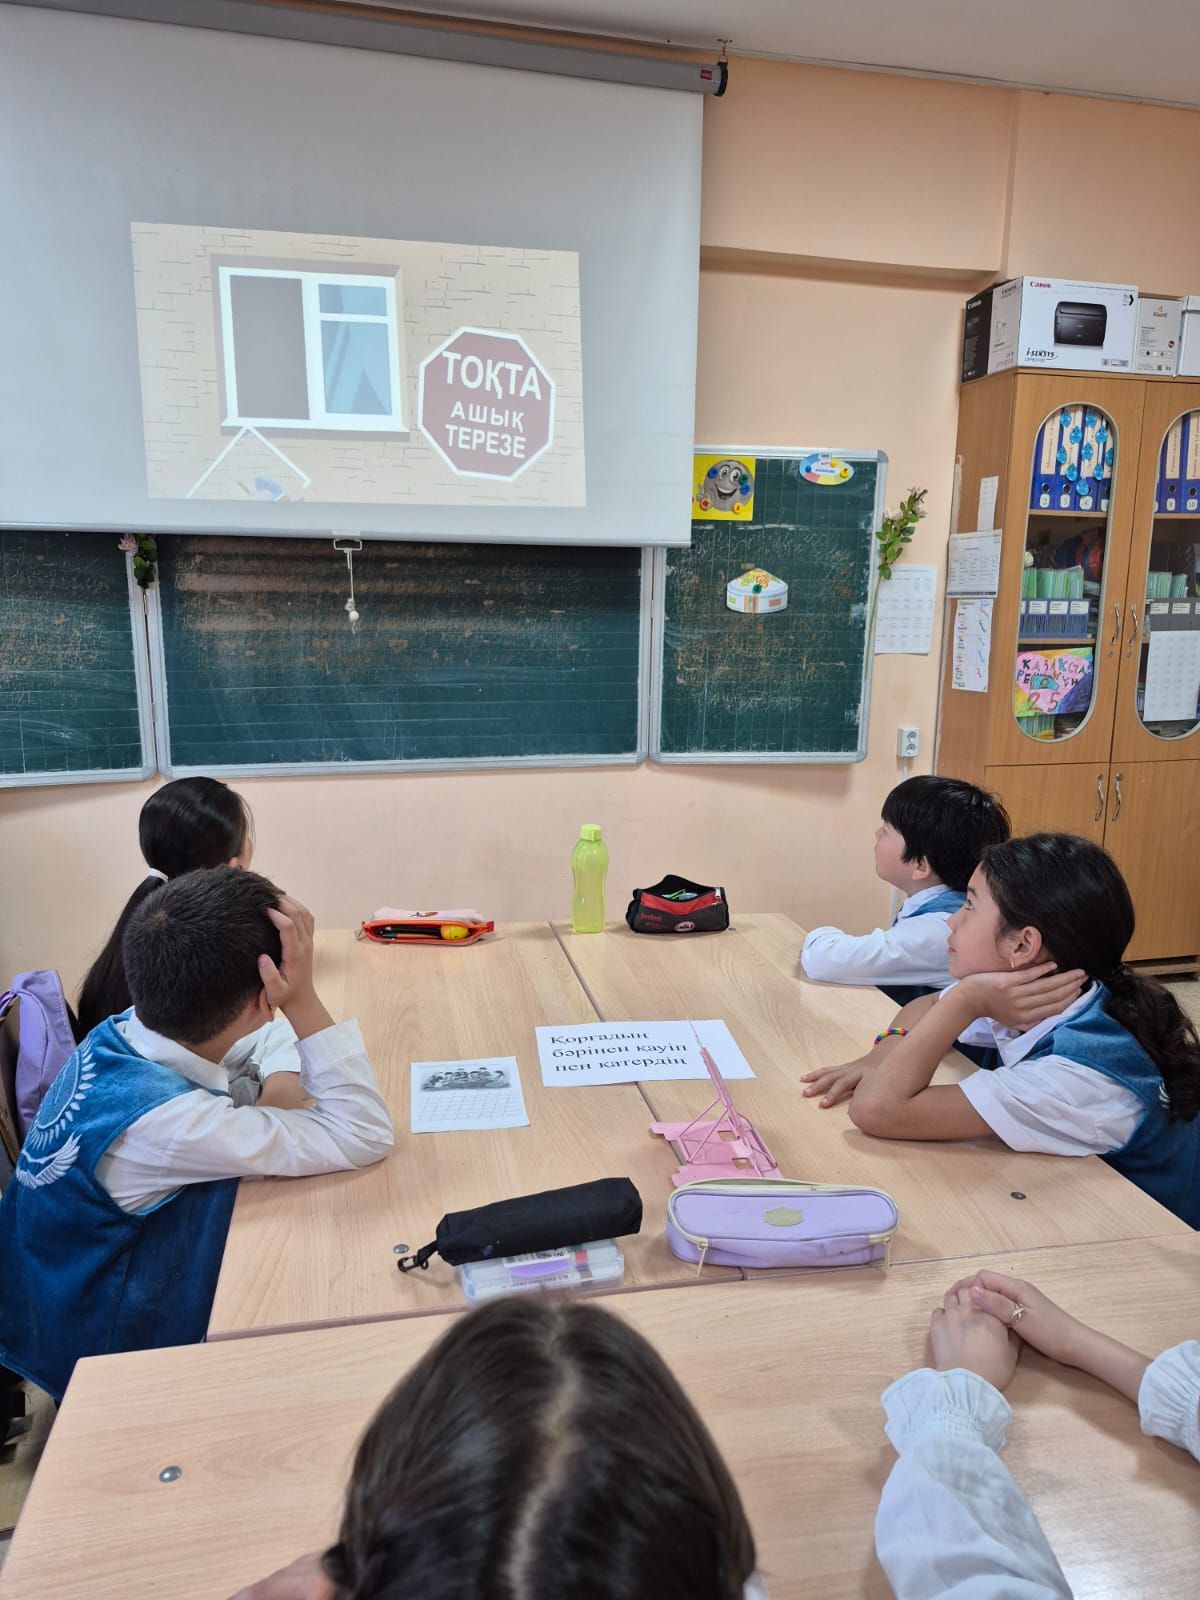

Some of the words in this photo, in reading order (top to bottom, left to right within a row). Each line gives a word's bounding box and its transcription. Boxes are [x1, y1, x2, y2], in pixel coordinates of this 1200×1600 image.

[1029, 281, 1052, 289] Canon
[442, 351, 542, 400] ТОҚТА
[451, 401, 525, 433] АШЫҚ
[445, 424, 526, 458] ТЕРЕЗЕ
[555, 1063, 592, 1072] пен
